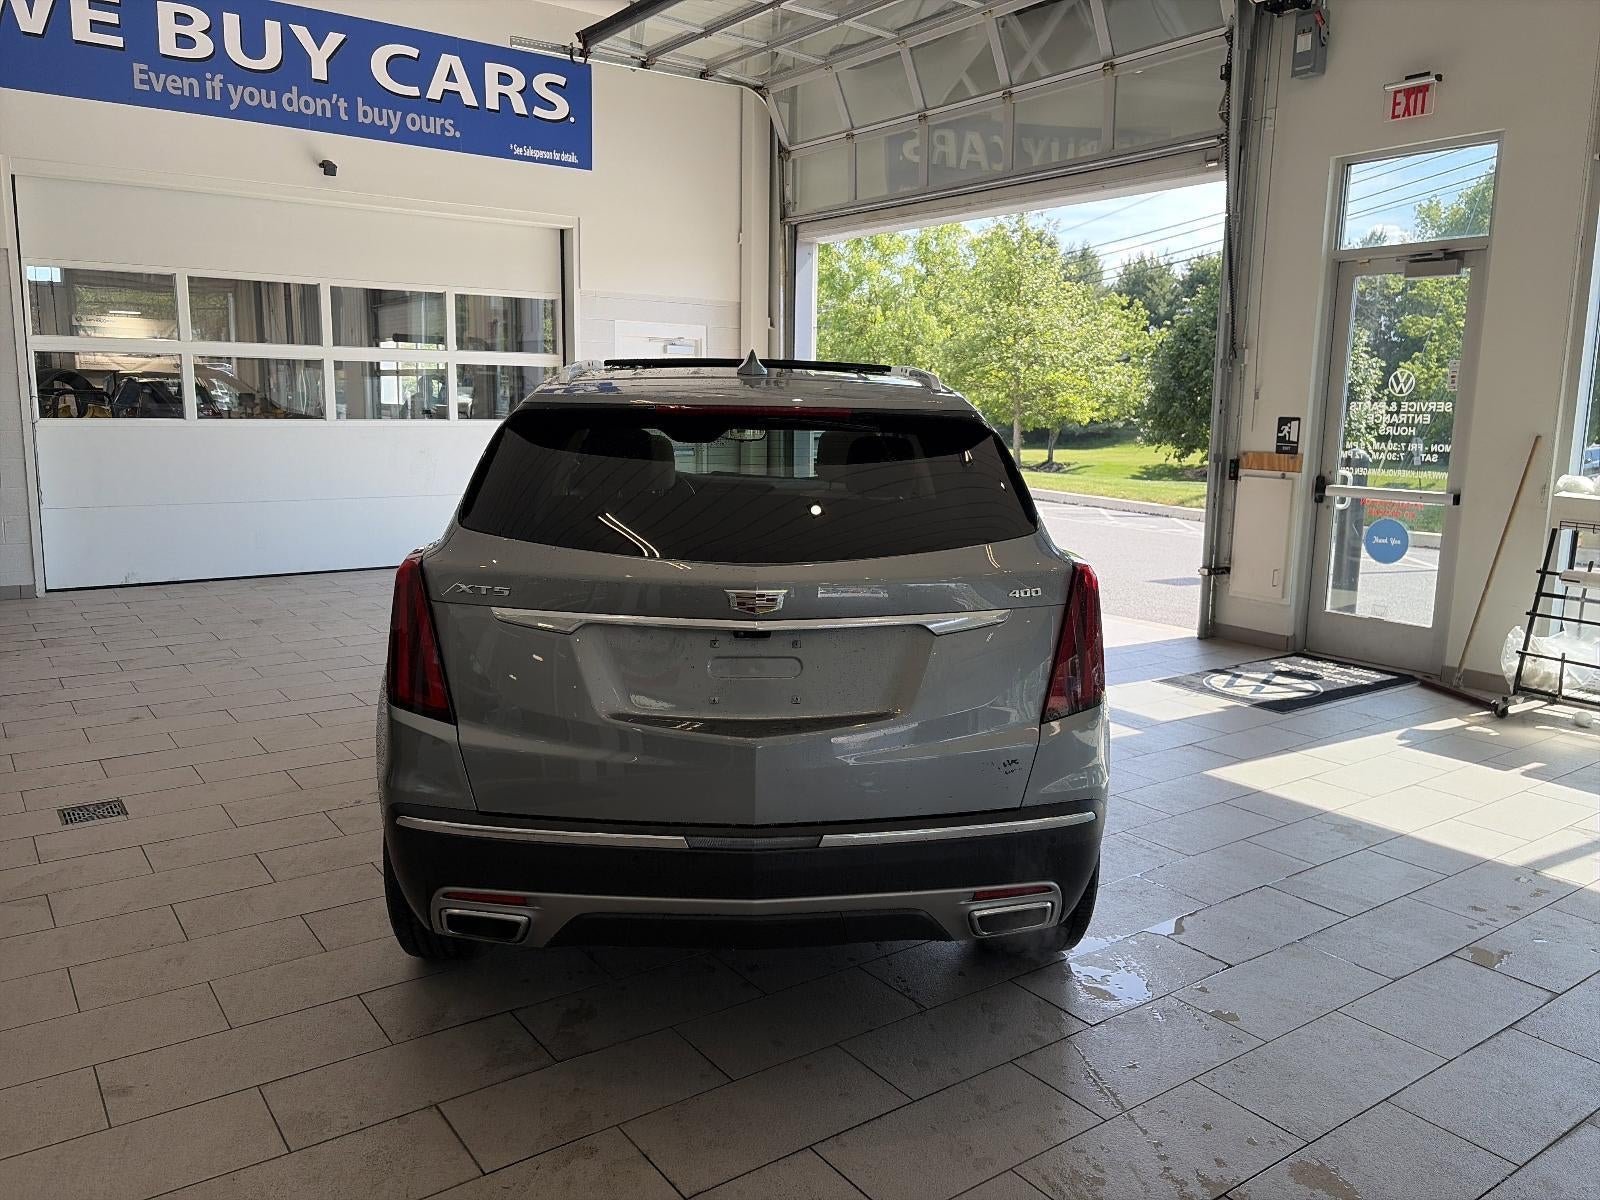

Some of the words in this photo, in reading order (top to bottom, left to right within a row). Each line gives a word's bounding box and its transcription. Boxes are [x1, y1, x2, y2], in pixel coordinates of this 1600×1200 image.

[156, 0, 347, 82] BUY
[370, 43, 576, 123] CARS.
[132, 62, 200, 98] Even
[205, 72, 223, 100] if
[228, 83, 276, 110] you
[282, 85, 349, 121] don't
[357, 97, 402, 134] buy
[406, 112, 461, 138] ours.
[1390, 84, 1430, 120] EXIT
[523, 145, 553, 160] Salesperson
[553, 149, 561, 161] for
[1009, 587, 1042, 598] 400
